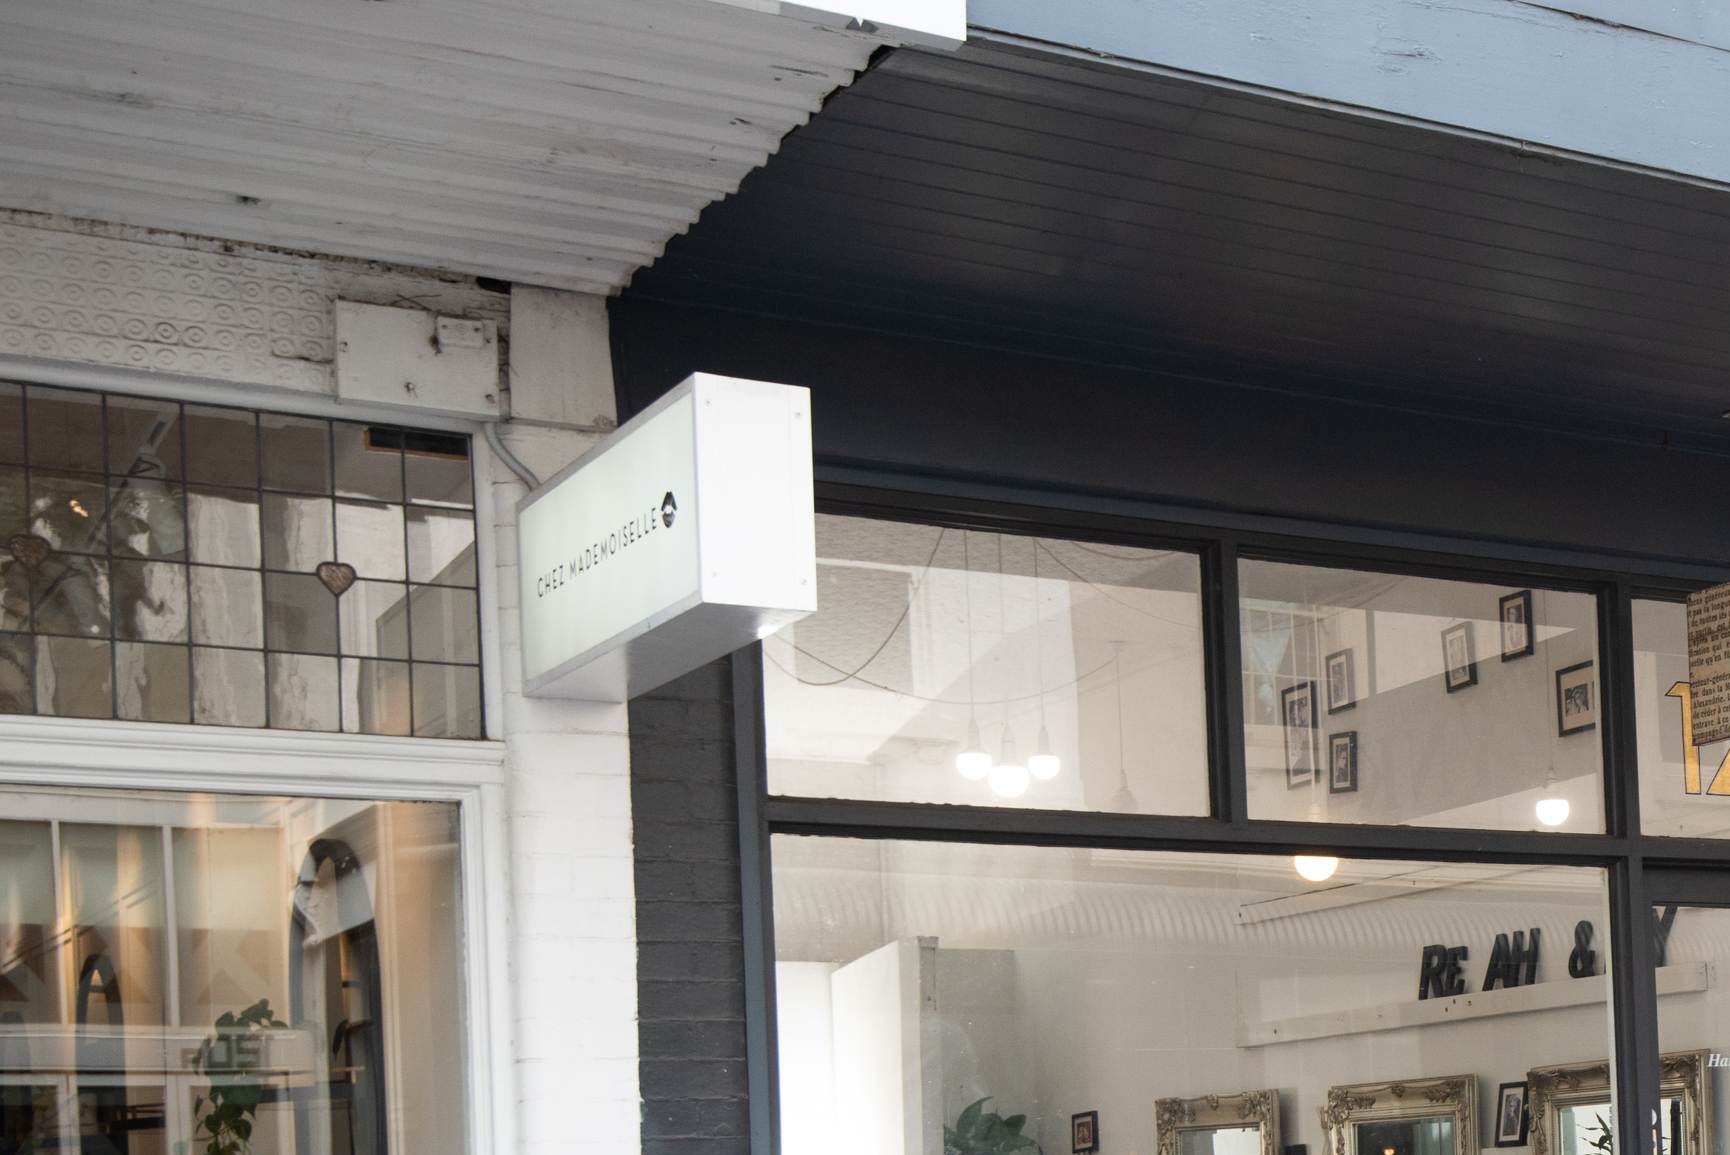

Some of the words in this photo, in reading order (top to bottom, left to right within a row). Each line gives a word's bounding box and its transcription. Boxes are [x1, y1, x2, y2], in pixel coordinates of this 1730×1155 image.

[537, 565, 564, 598] CHEZ
[569, 507, 657, 580] MADEMOISELLE
[1568, 919, 1596, 979] &
